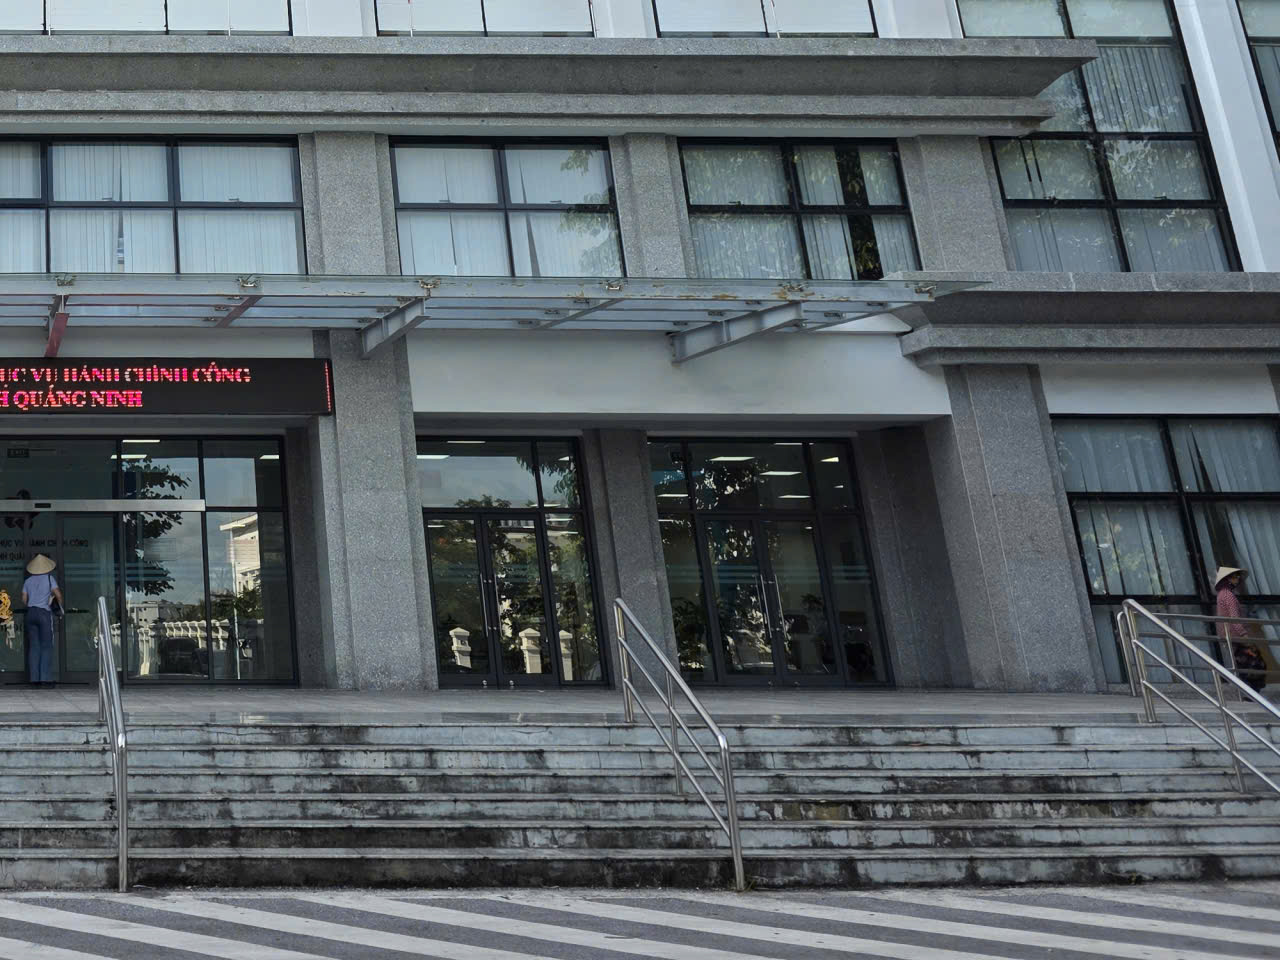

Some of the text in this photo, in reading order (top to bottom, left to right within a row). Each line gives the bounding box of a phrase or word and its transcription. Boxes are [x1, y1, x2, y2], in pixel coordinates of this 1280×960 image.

[124, 364, 188, 382] CHÍNH
[192, 361, 252, 382] CÔNG
[90, 390, 143, 407] NINH
